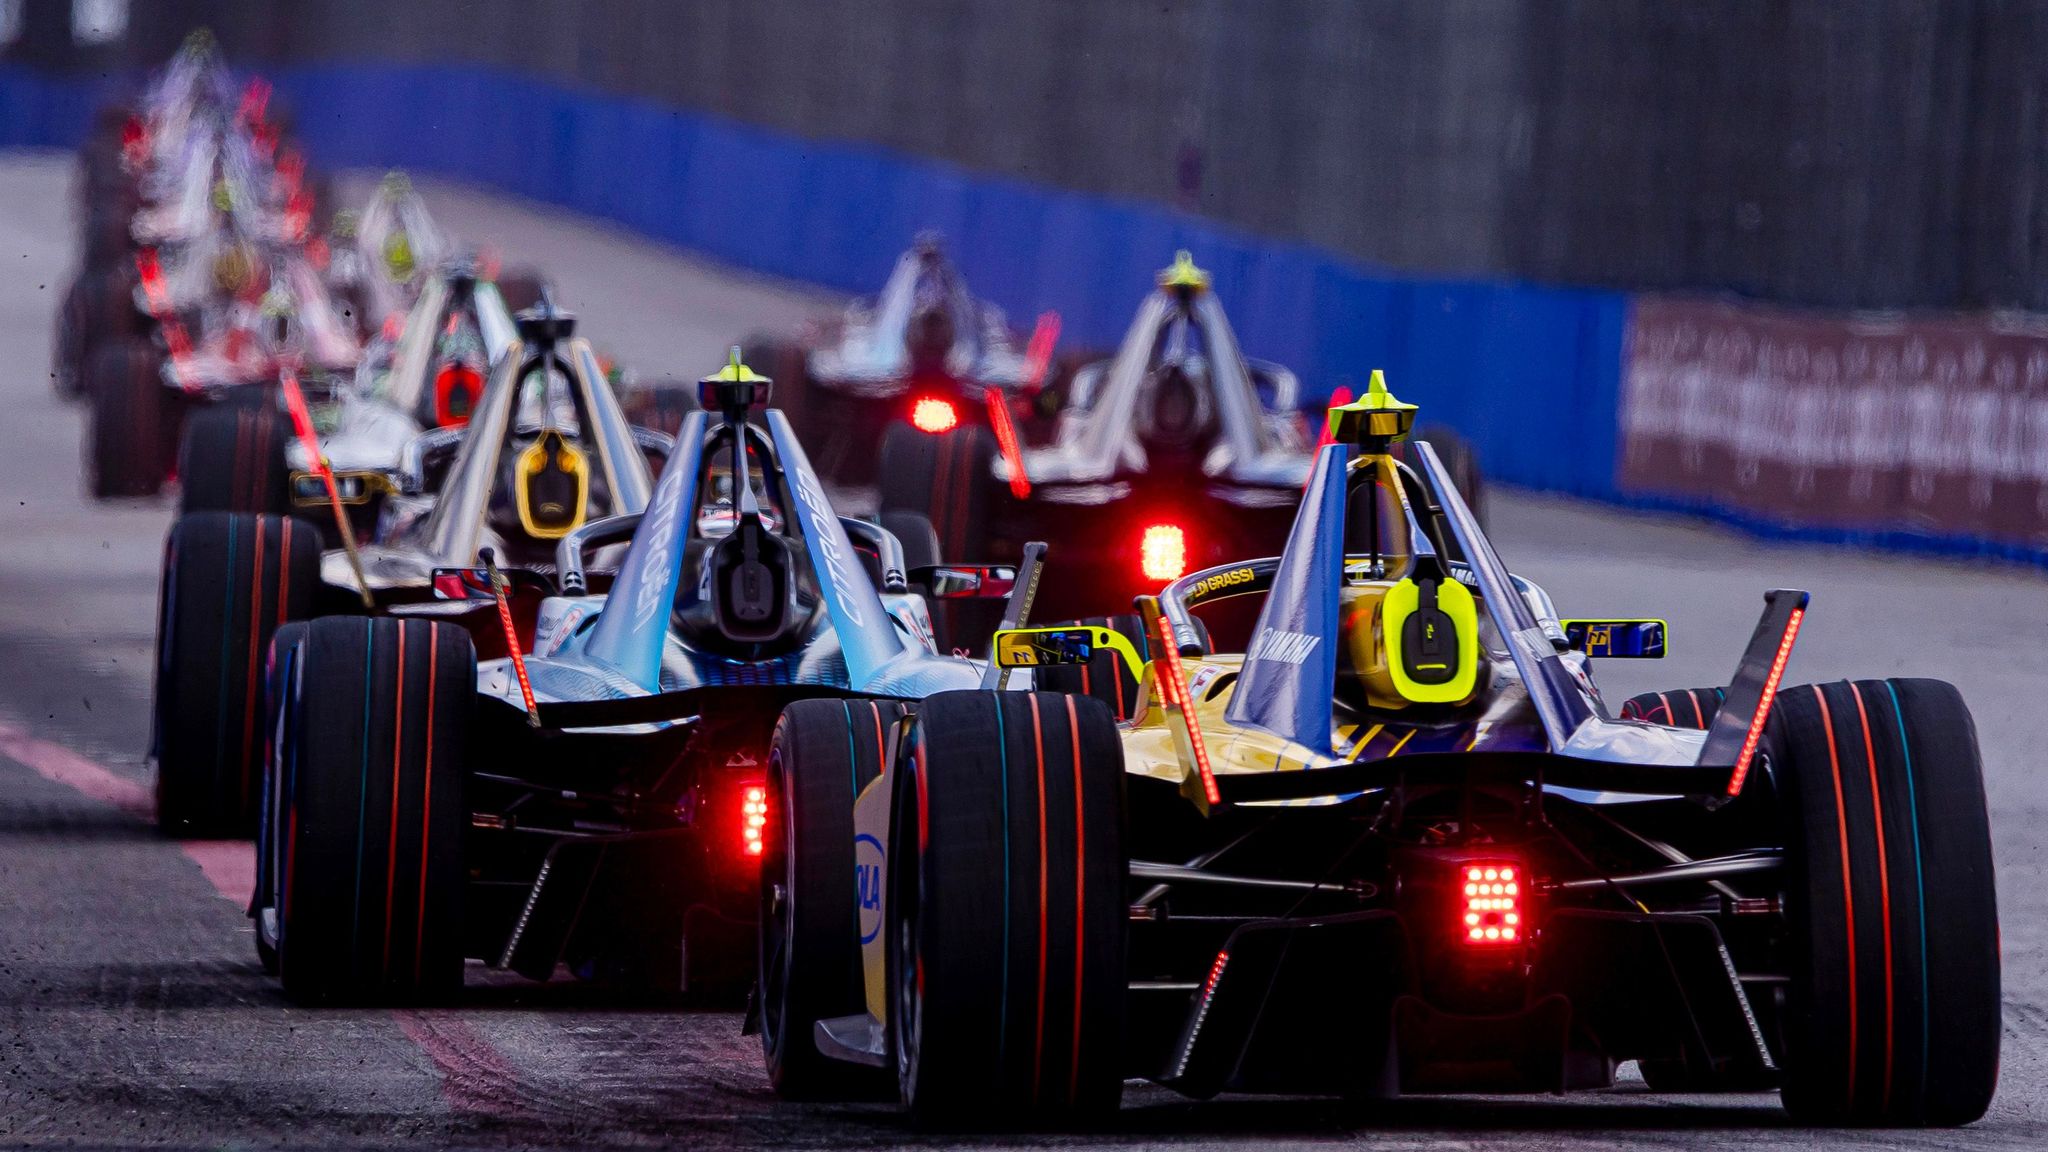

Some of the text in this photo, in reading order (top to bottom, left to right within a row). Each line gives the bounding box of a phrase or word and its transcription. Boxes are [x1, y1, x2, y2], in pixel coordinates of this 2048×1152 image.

[796, 467, 863, 628] CITROËN
[1208, 567, 1255, 591] GRASSI
[1259, 630, 1321, 665] YAMAHA
[856, 864, 880, 911] OLA
